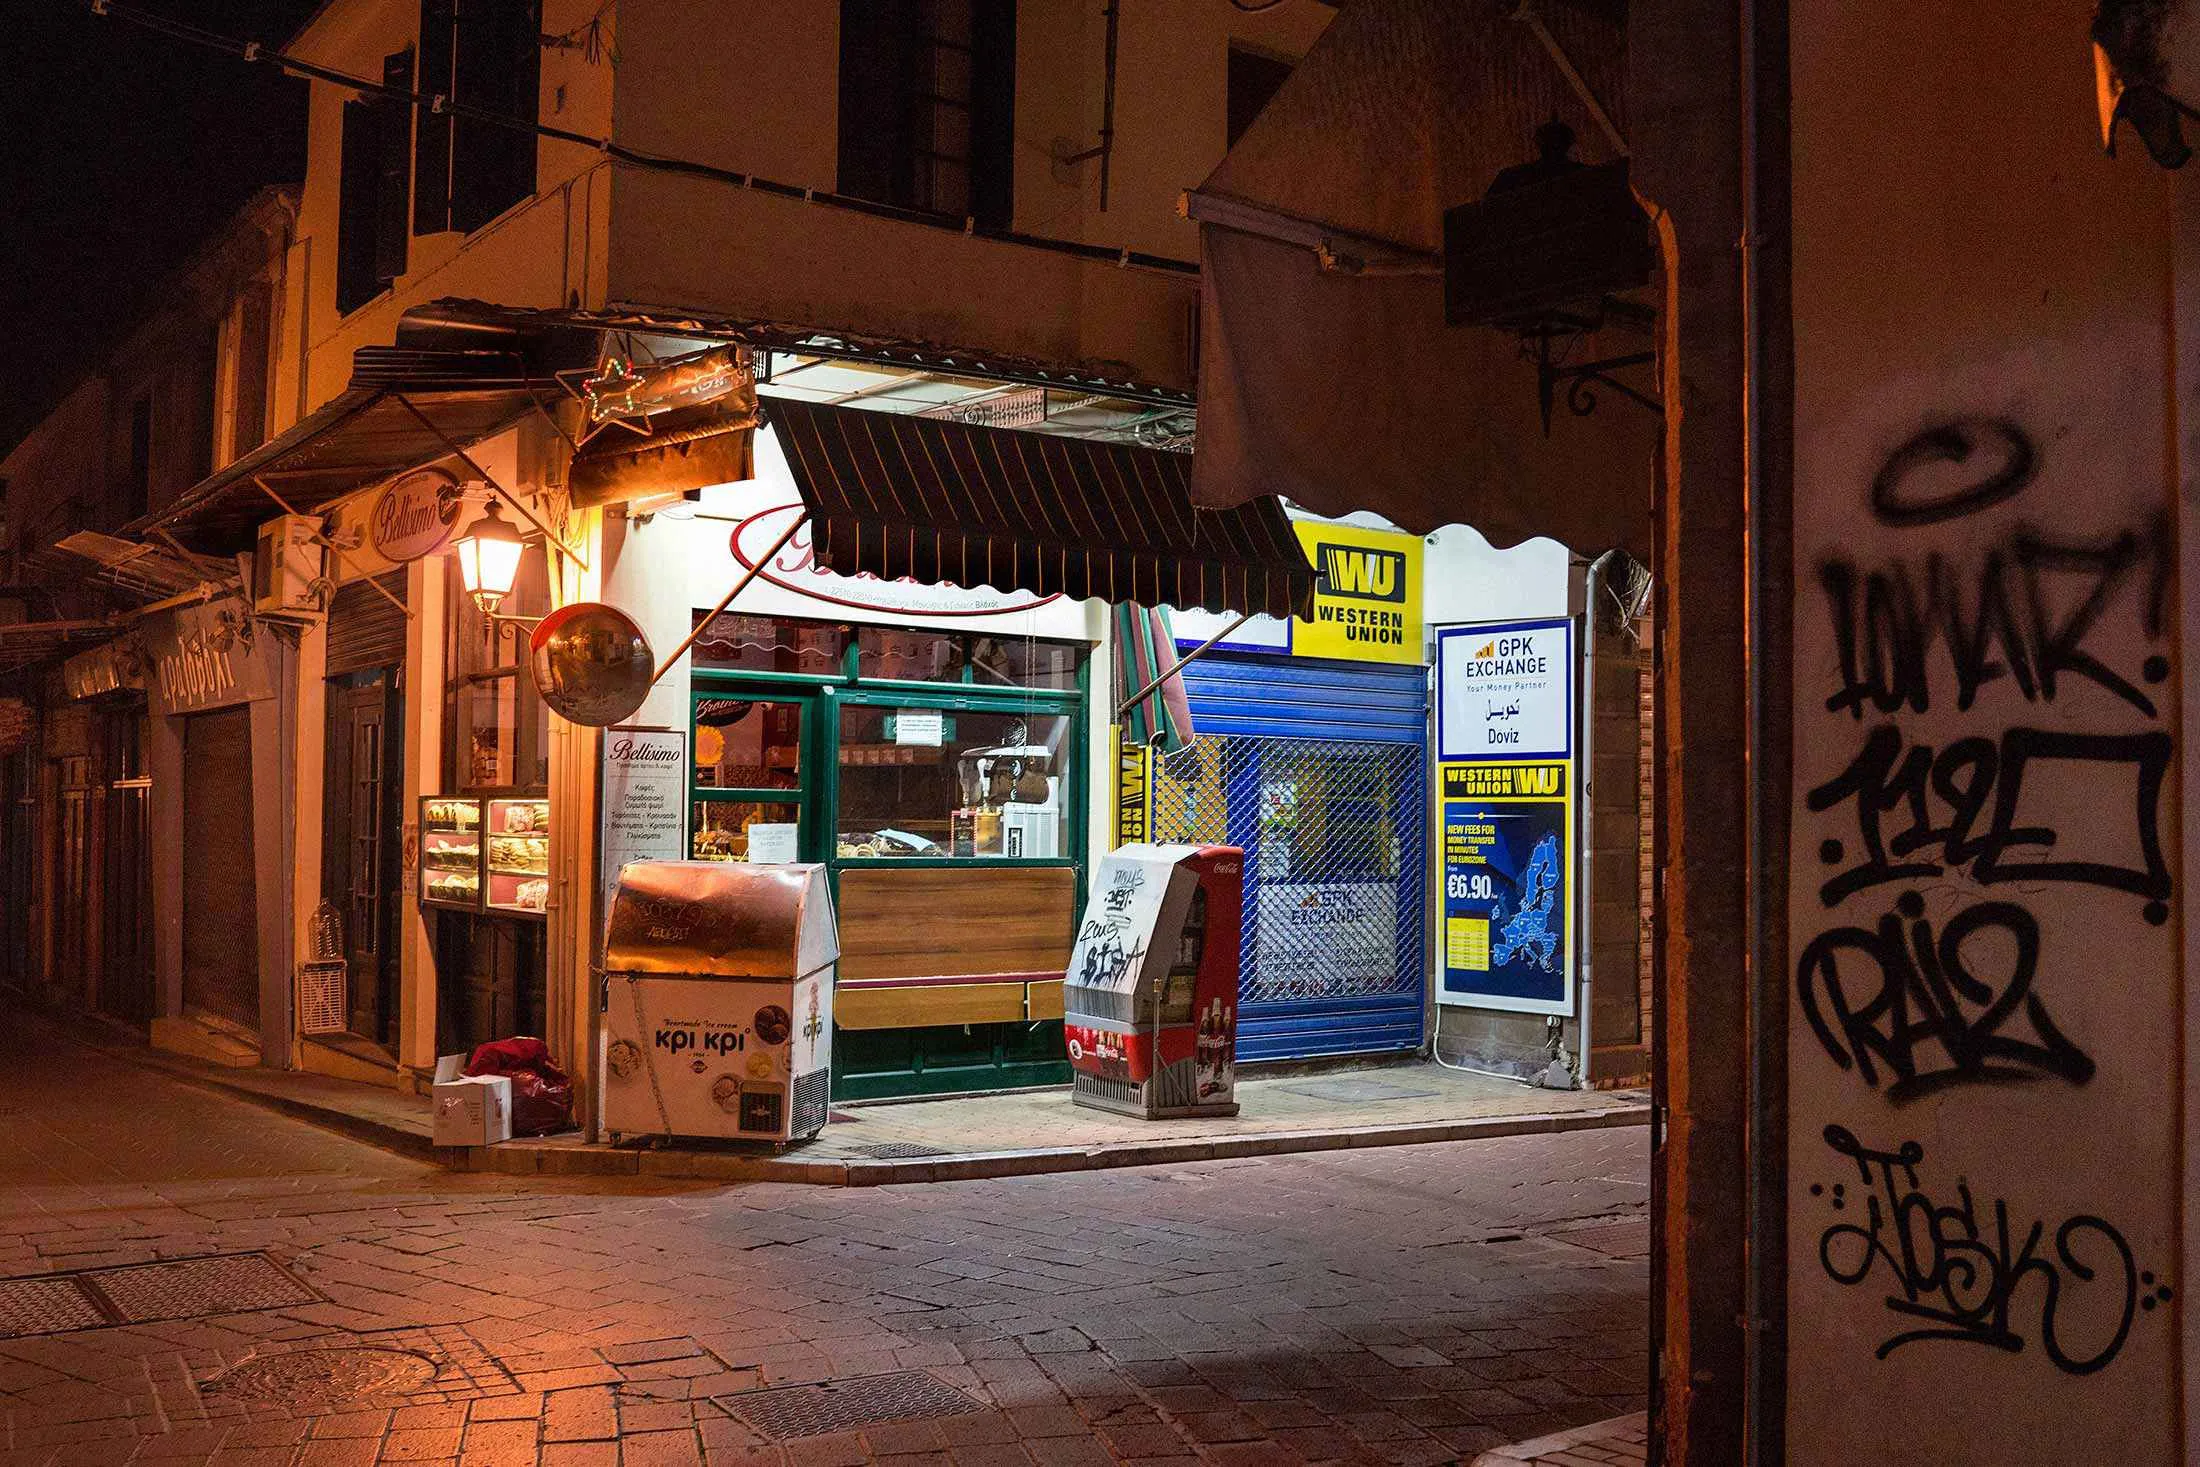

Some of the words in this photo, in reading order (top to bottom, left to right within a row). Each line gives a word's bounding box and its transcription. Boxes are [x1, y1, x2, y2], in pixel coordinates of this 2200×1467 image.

[377, 493, 437, 545] Bellisimo
[1333, 549, 1396, 596] WU
[1318, 605, 1402, 627] WESTERN
[1346, 625, 1402, 645] UNION
[1499, 637, 1534, 656] GPK
[1466, 657, 1546, 677] EXCHANGE
[1467, 685, 1484, 693] Your
[1487, 683, 1512, 692] Money
[1515, 681, 1547, 689] Partner
[1488, 728, 1519, 744] Doviz
[609, 739, 681, 761] Bellisimo
[1447, 769, 1512, 782] WESTERN
[1519, 768, 1559, 794] WU
[1466, 782, 1512, 794] UNION
[1447, 825, 1464, 835] NEW
[1465, 825, 1481, 835] FEES
[1482, 825, 1496, 836] FOR
[1447, 836, 1467, 845] MONEY
[1468, 836, 1496, 845] TRANSFER
[1455, 846, 1479, 855] MINUTES
[1459, 856, 1487, 865] EUROZONE
[1447, 874, 1492, 900] €6.90
